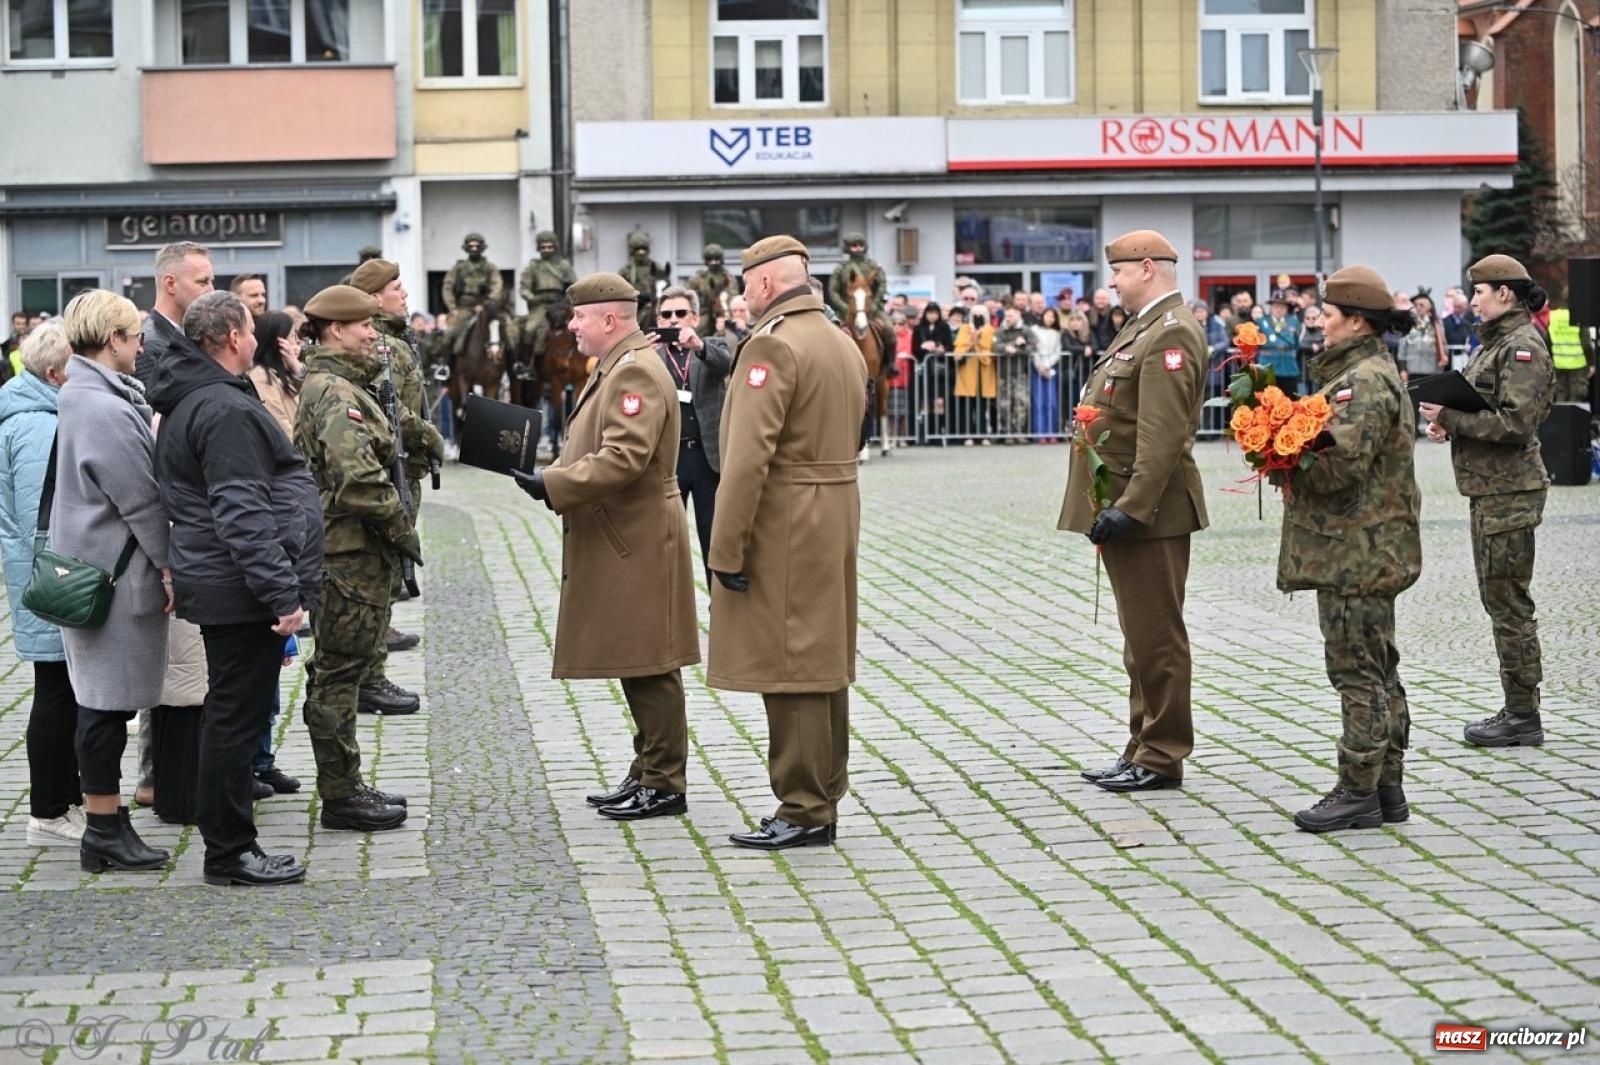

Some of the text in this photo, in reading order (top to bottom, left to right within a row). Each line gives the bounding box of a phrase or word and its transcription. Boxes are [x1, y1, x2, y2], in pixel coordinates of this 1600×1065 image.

[756, 126, 812, 147] TEB
[1101, 117, 1364, 155] ROSSMANN
[756, 151, 813, 161] EDUKACJA
